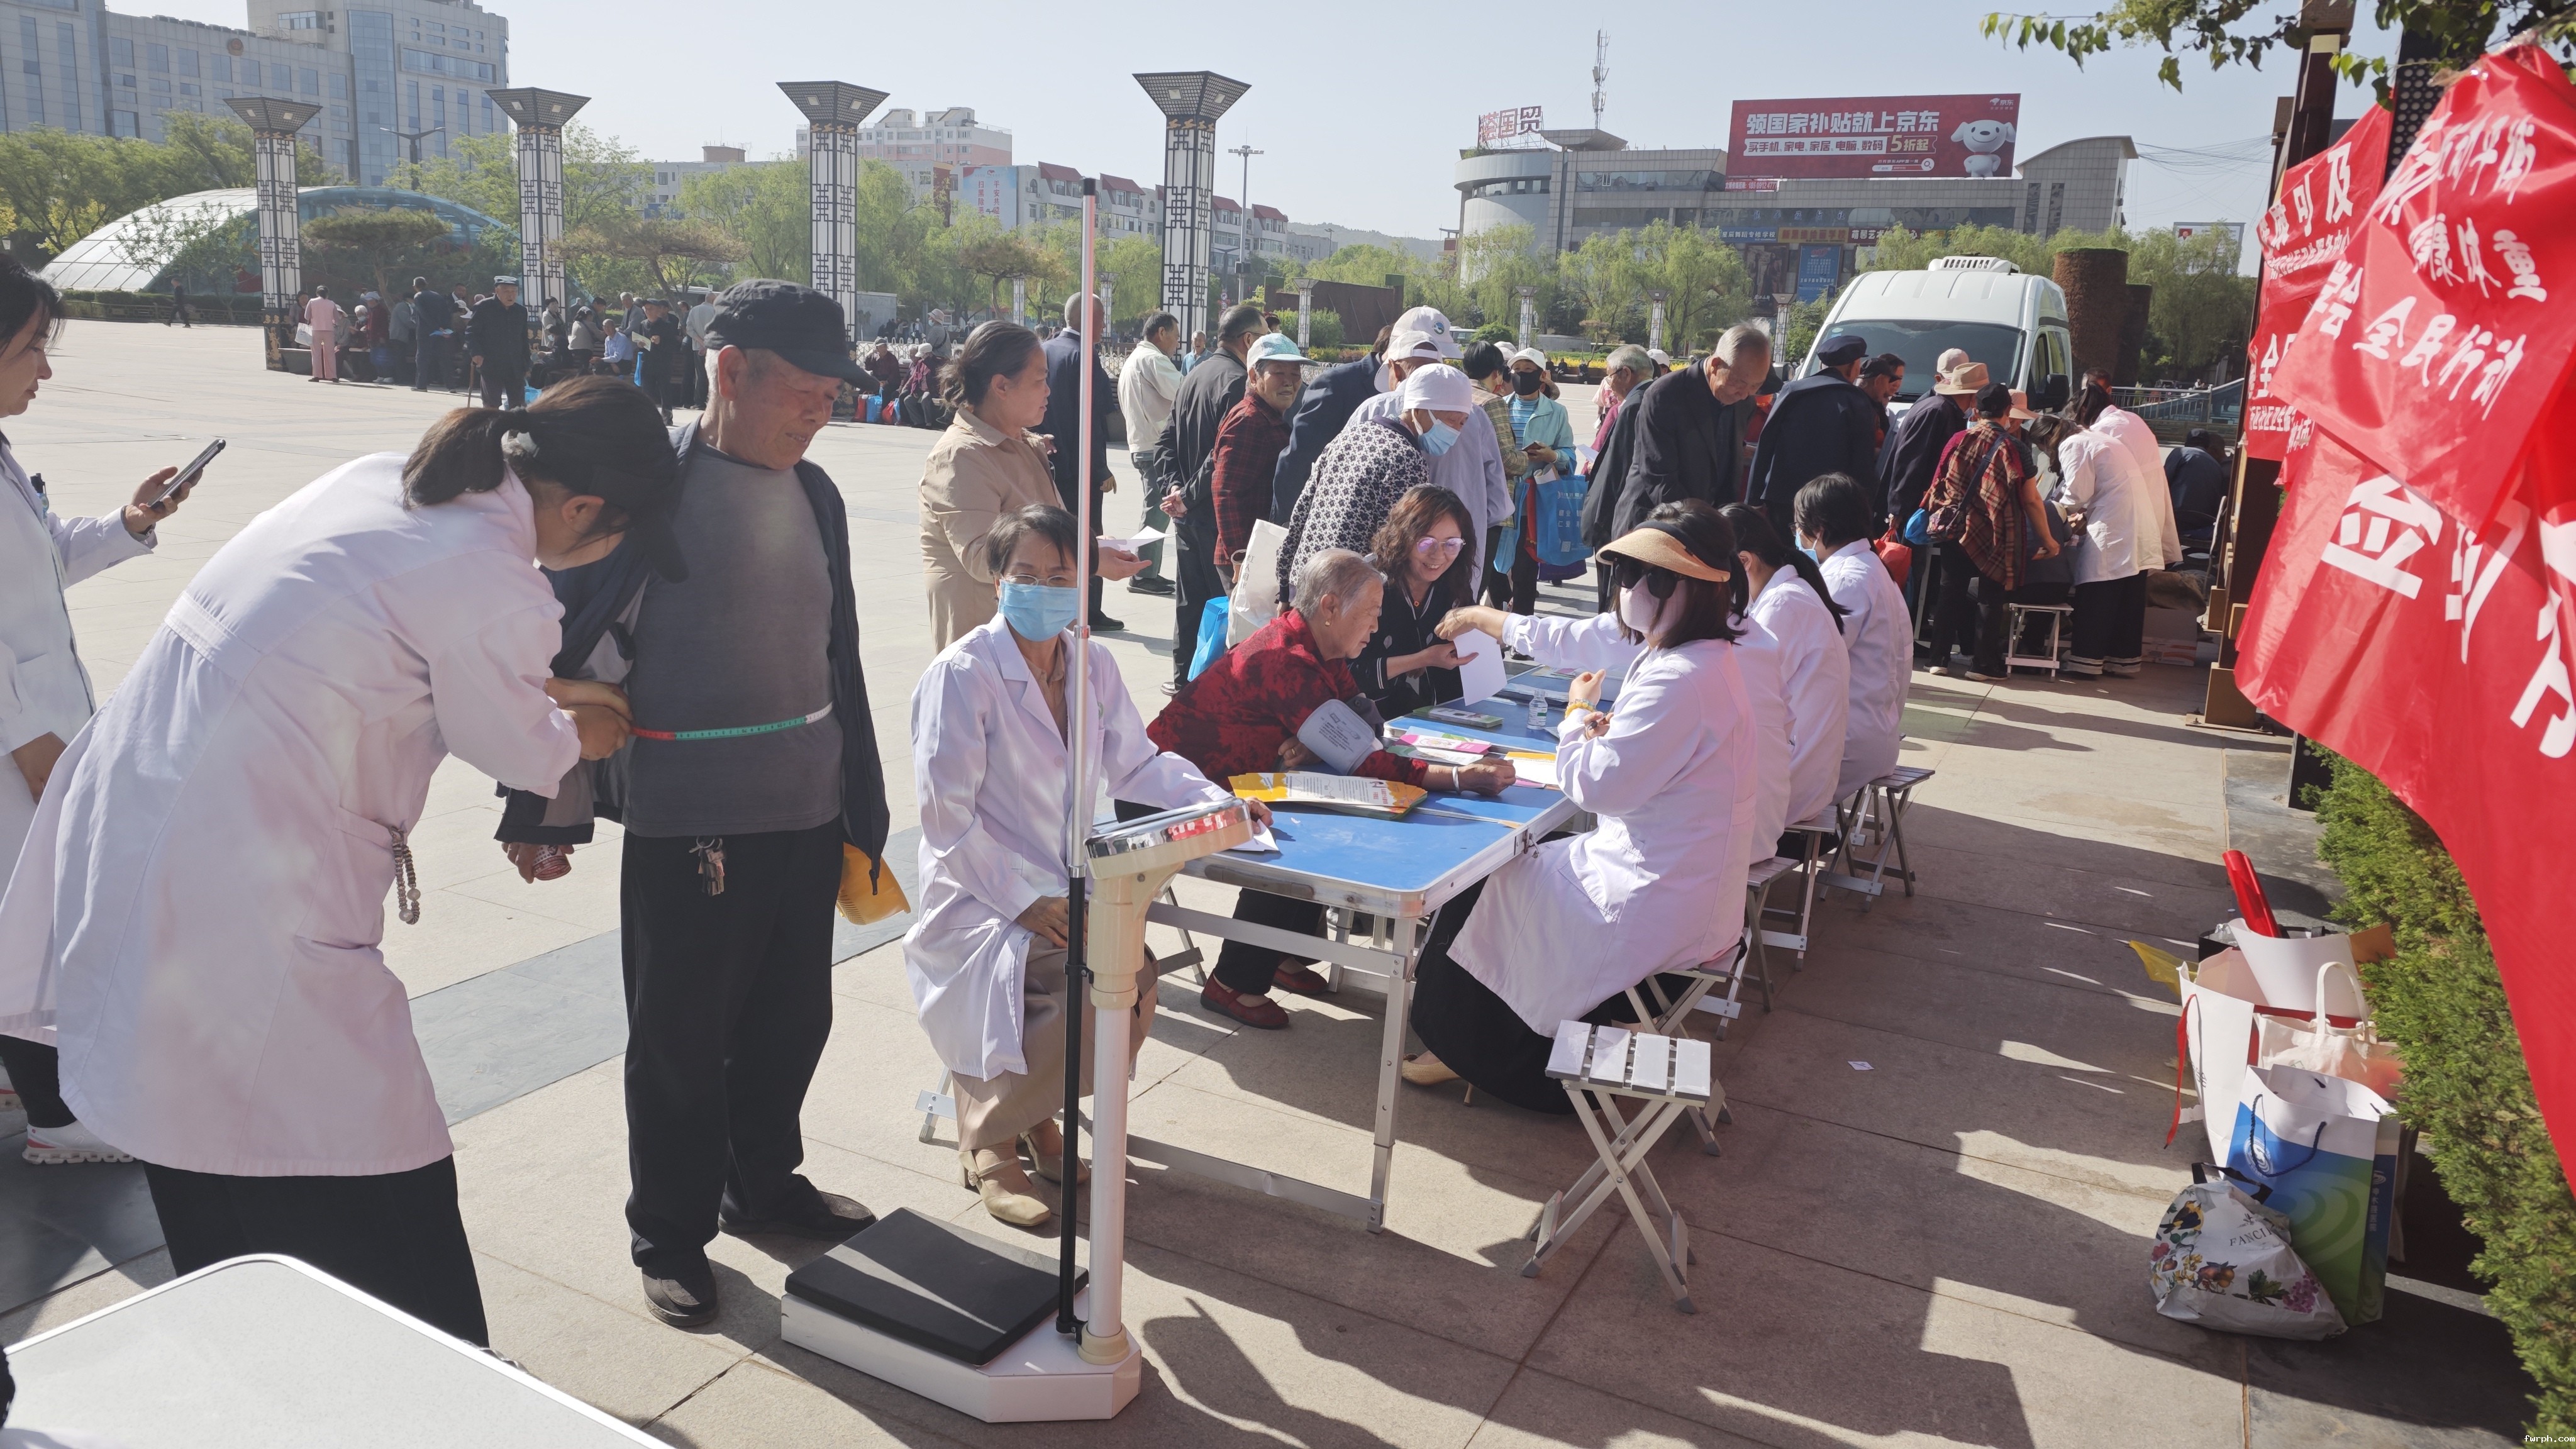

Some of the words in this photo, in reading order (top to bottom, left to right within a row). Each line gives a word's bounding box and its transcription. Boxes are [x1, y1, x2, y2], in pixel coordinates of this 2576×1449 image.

[1480, 105, 1541, 141] 荟国贸
[1746, 110, 1940, 135] 领国家补贴就上京东
[1890, 135, 1929, 153] 5折起
[2353, 296, 2526, 421] 全民行动
